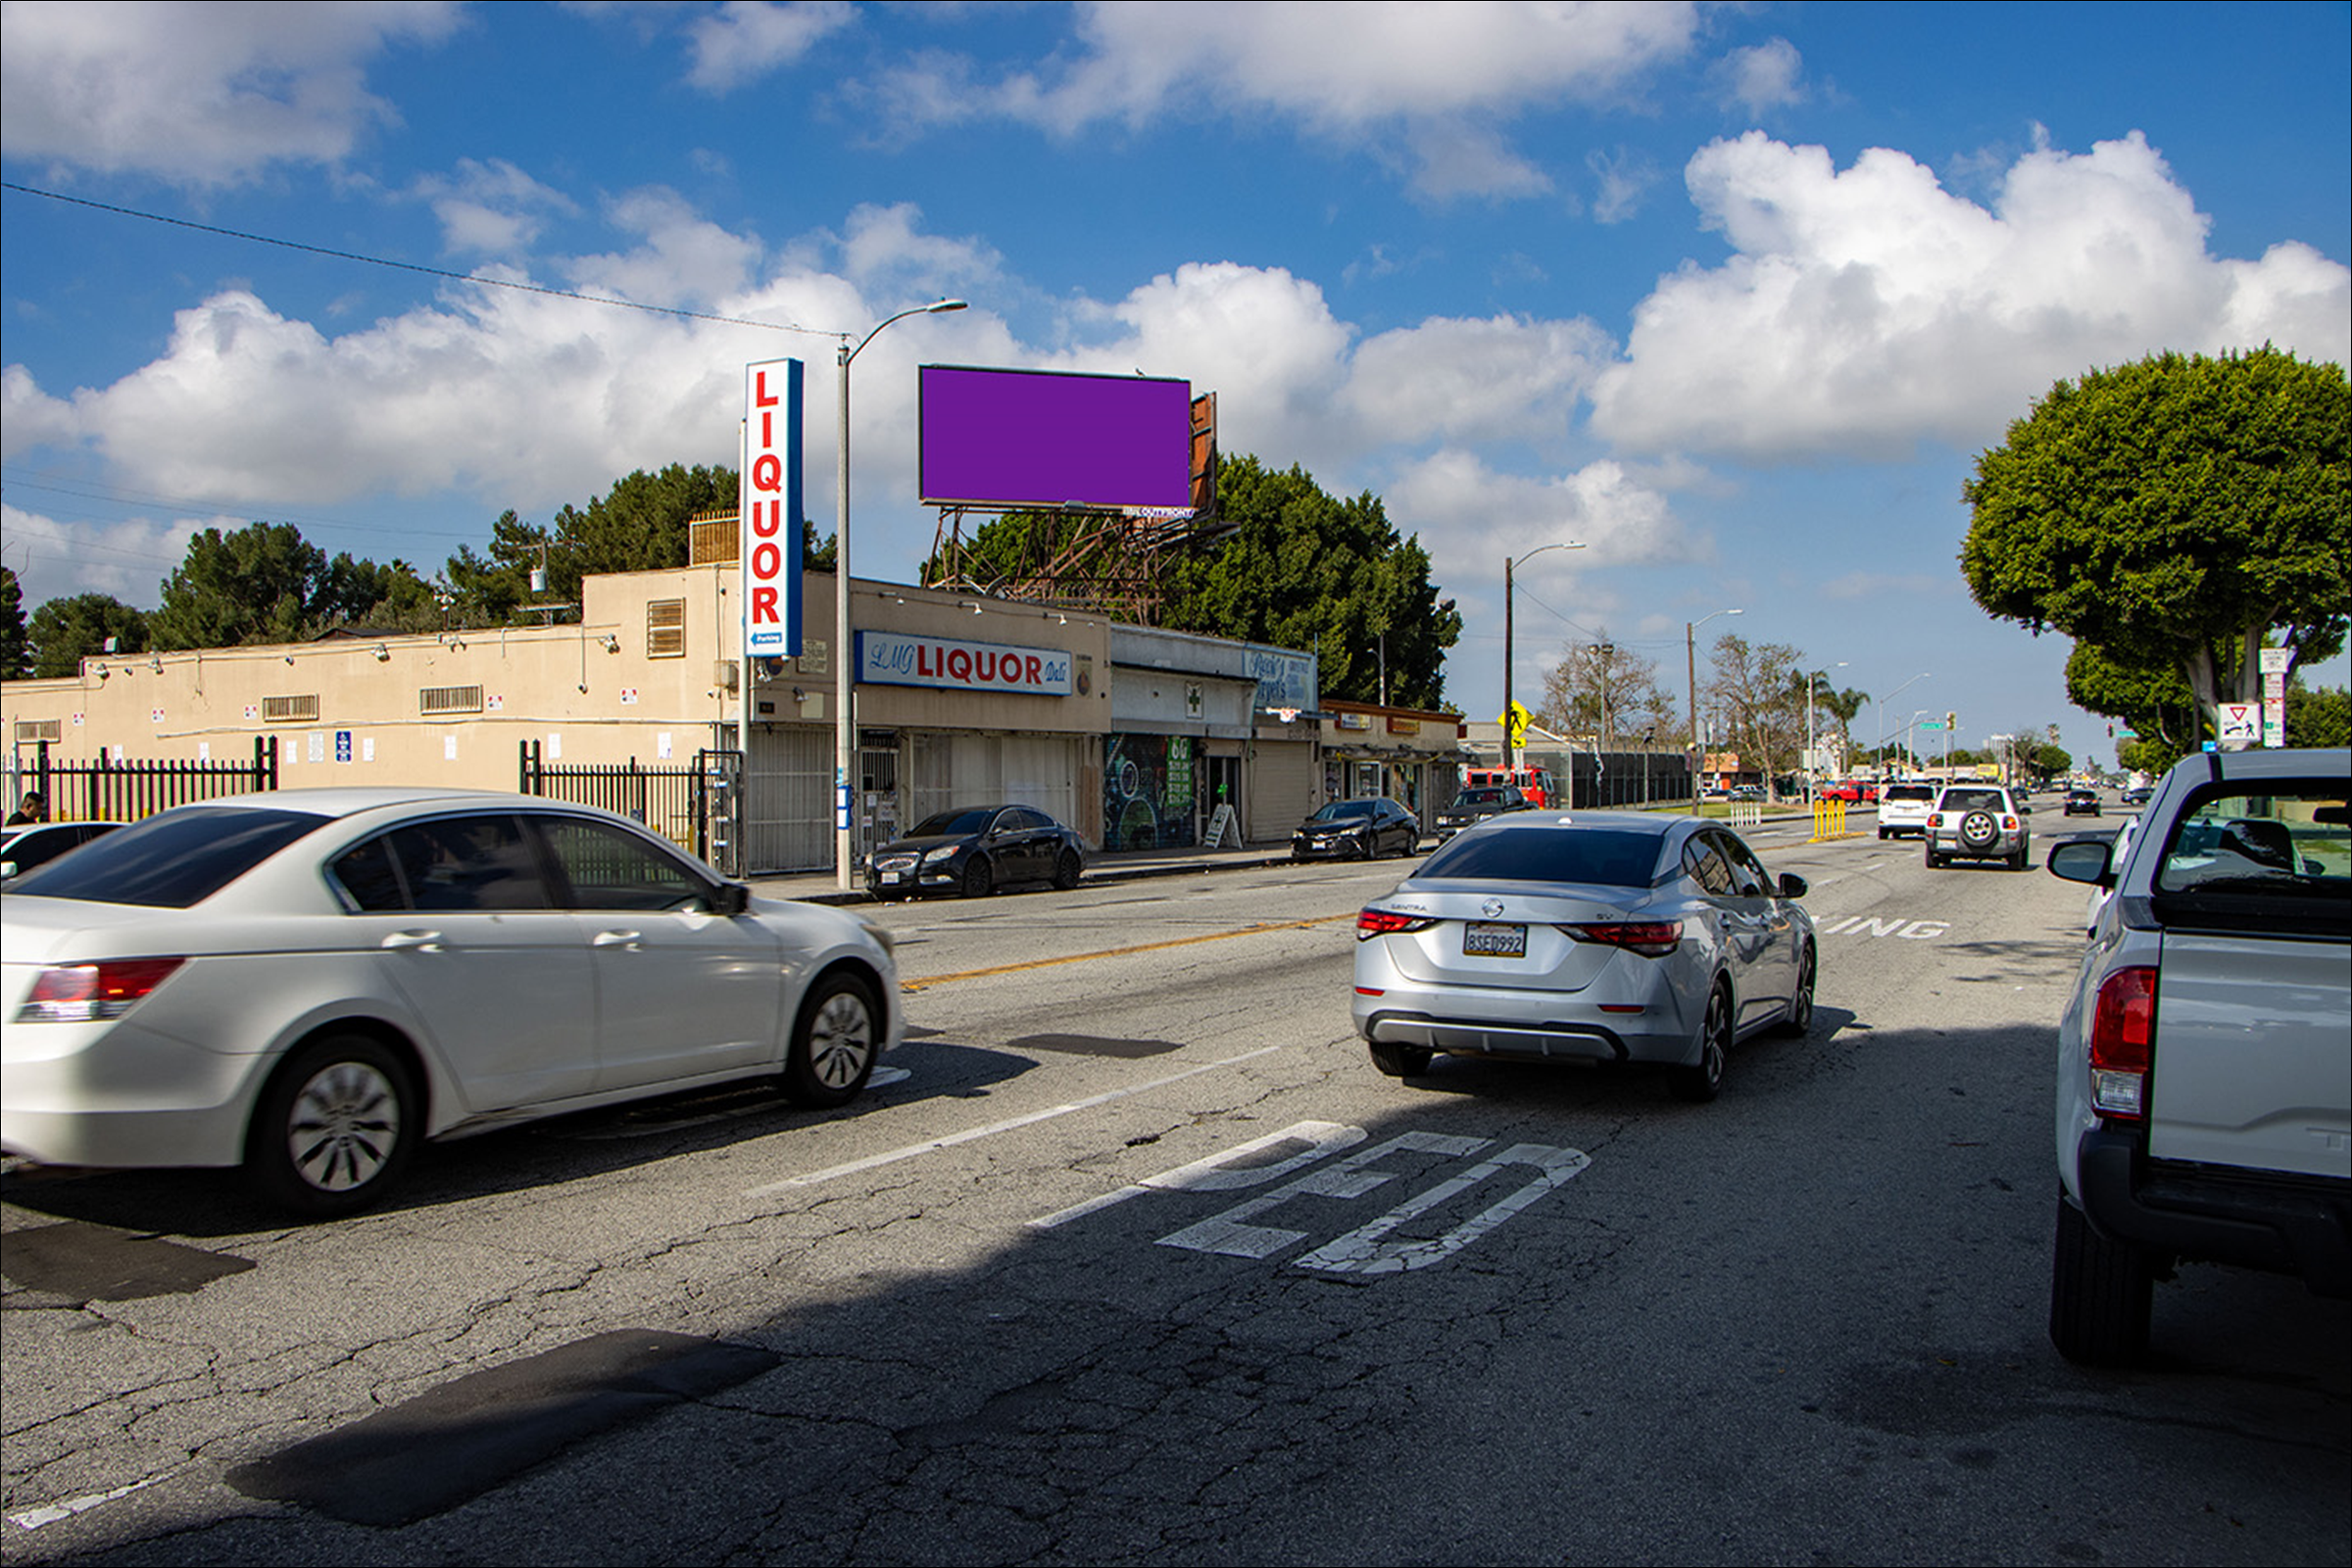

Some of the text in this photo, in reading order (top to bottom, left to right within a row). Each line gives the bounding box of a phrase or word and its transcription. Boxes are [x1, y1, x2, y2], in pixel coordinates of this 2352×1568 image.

[752, 371, 781, 624] LIQUOR
[917, 645, 1042, 685] LIQUOR
[1045, 661, 1066, 682] Deli
[1468, 934, 1522, 952] 8SED992
[1811, 915, 1951, 940] ING
[1024, 1119, 1592, 1274] PED
